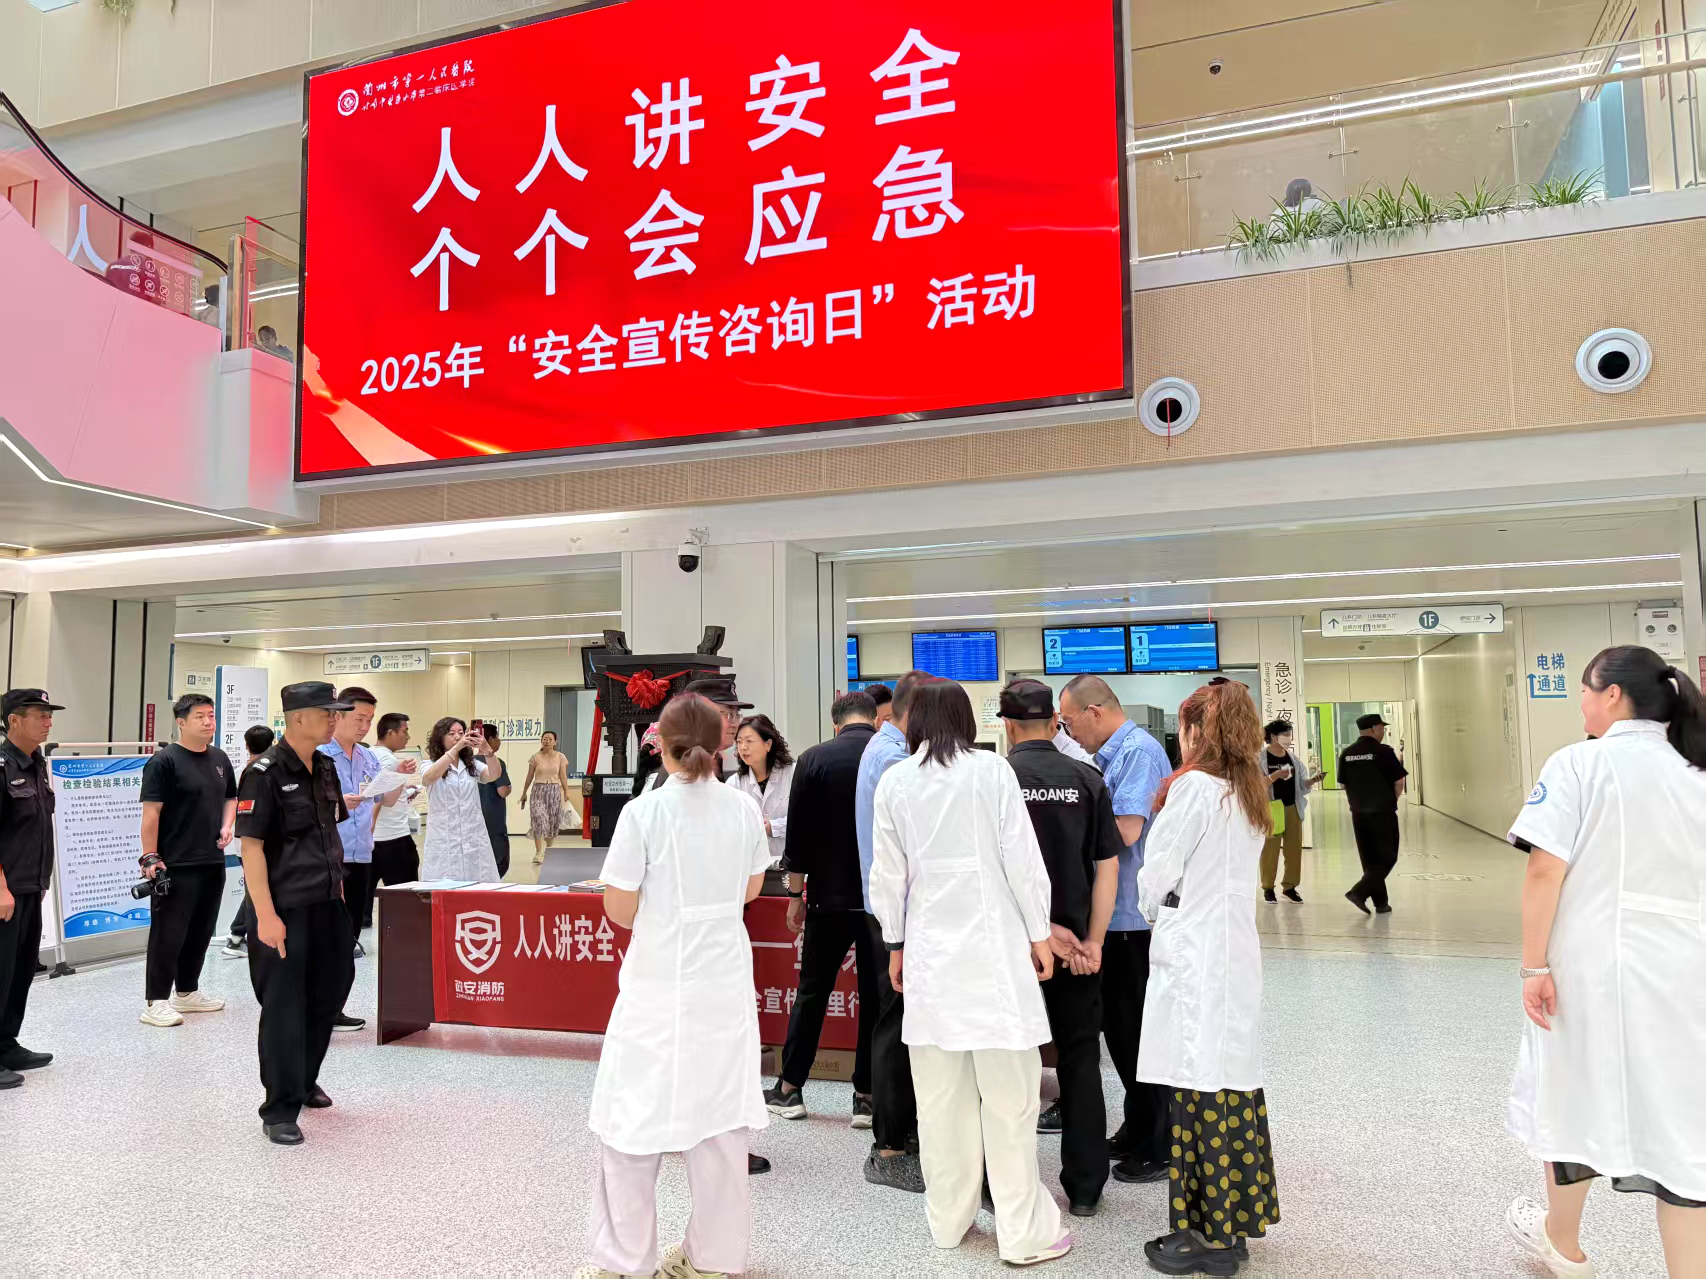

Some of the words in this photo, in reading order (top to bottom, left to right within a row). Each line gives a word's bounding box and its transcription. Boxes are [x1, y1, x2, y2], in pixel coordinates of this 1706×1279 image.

[411, 28, 961, 214] 人人讲安全
[409, 144, 965, 312] 个个会应急
[1422, 613, 1435, 627] 1F
[1049, 638, 1058, 650] 2
[1136, 635, 1143, 647] 1
[1537, 653, 1565, 671] 电梯
[226, 684, 235, 695] 3F
[1537, 674, 1566, 691] 通道
[485, 718, 542, 738] 门诊测视力
[225, 734, 234, 745] 2F
[63, 777, 141, 790] 检查检验结果相关
[1021, 787, 1080, 803] BAOAN安
